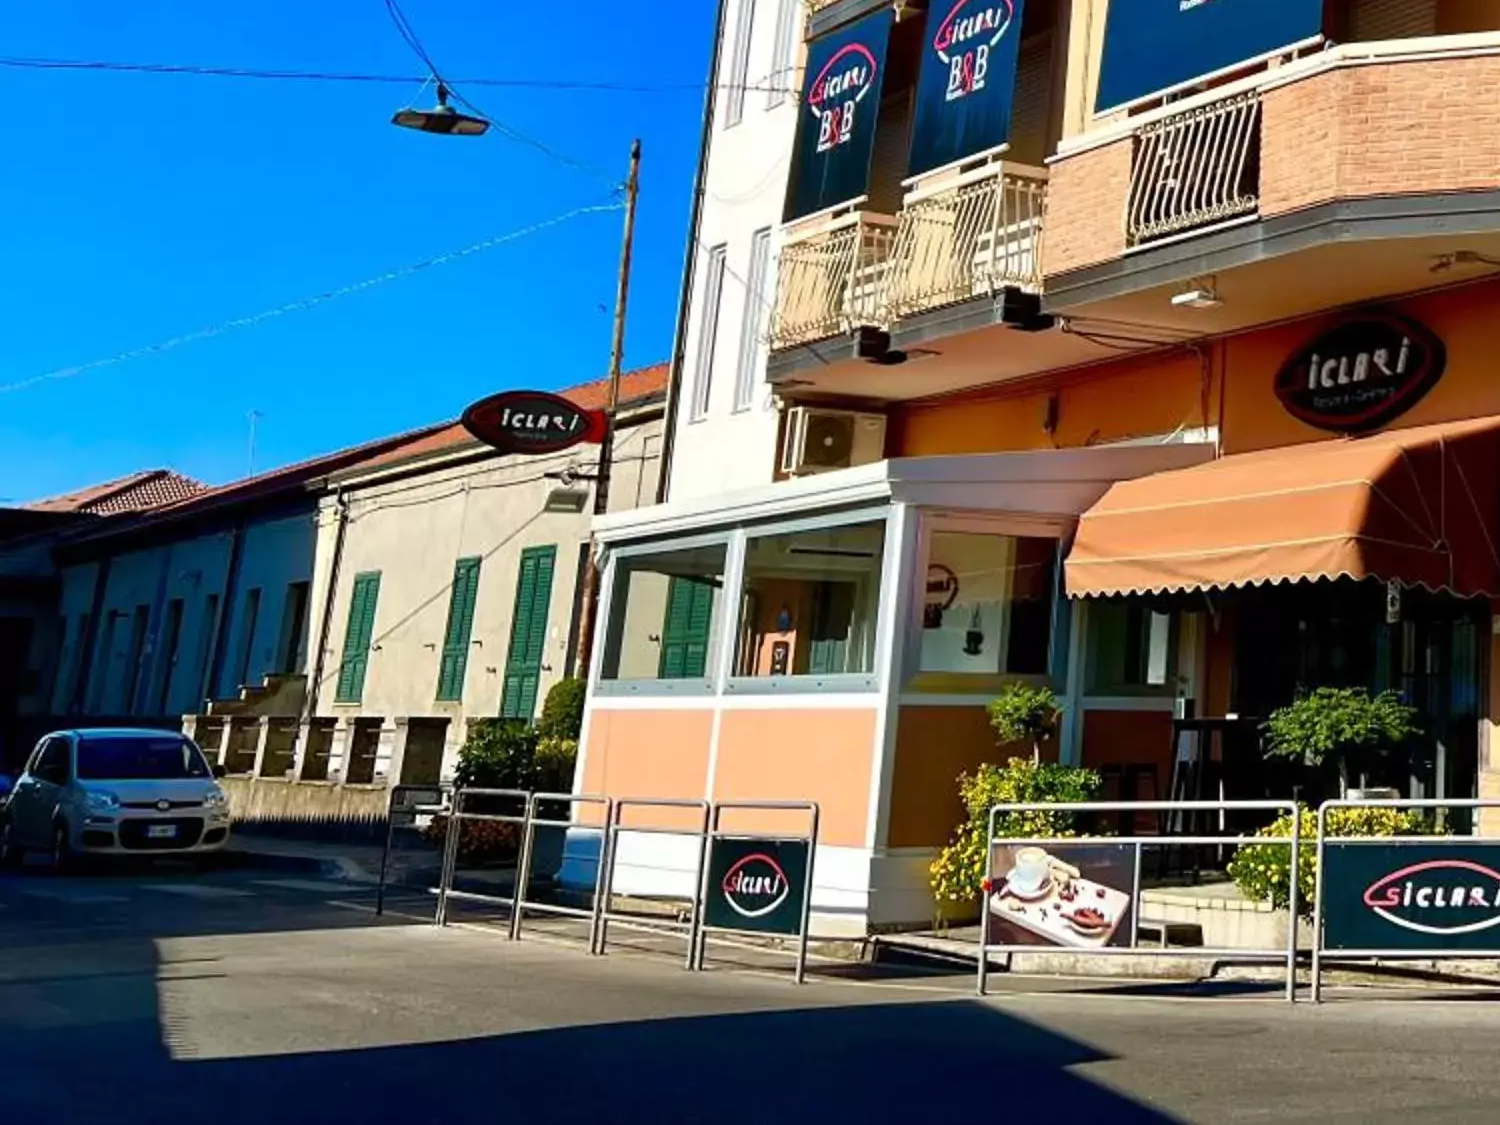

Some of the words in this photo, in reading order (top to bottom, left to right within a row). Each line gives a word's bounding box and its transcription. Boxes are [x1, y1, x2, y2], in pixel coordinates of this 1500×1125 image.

[949, 44, 989, 93] B&B
[820, 100, 855, 145] B&B
[1296, 336, 1410, 390] iCLARi
[500, 408, 580, 431] iCLARi
